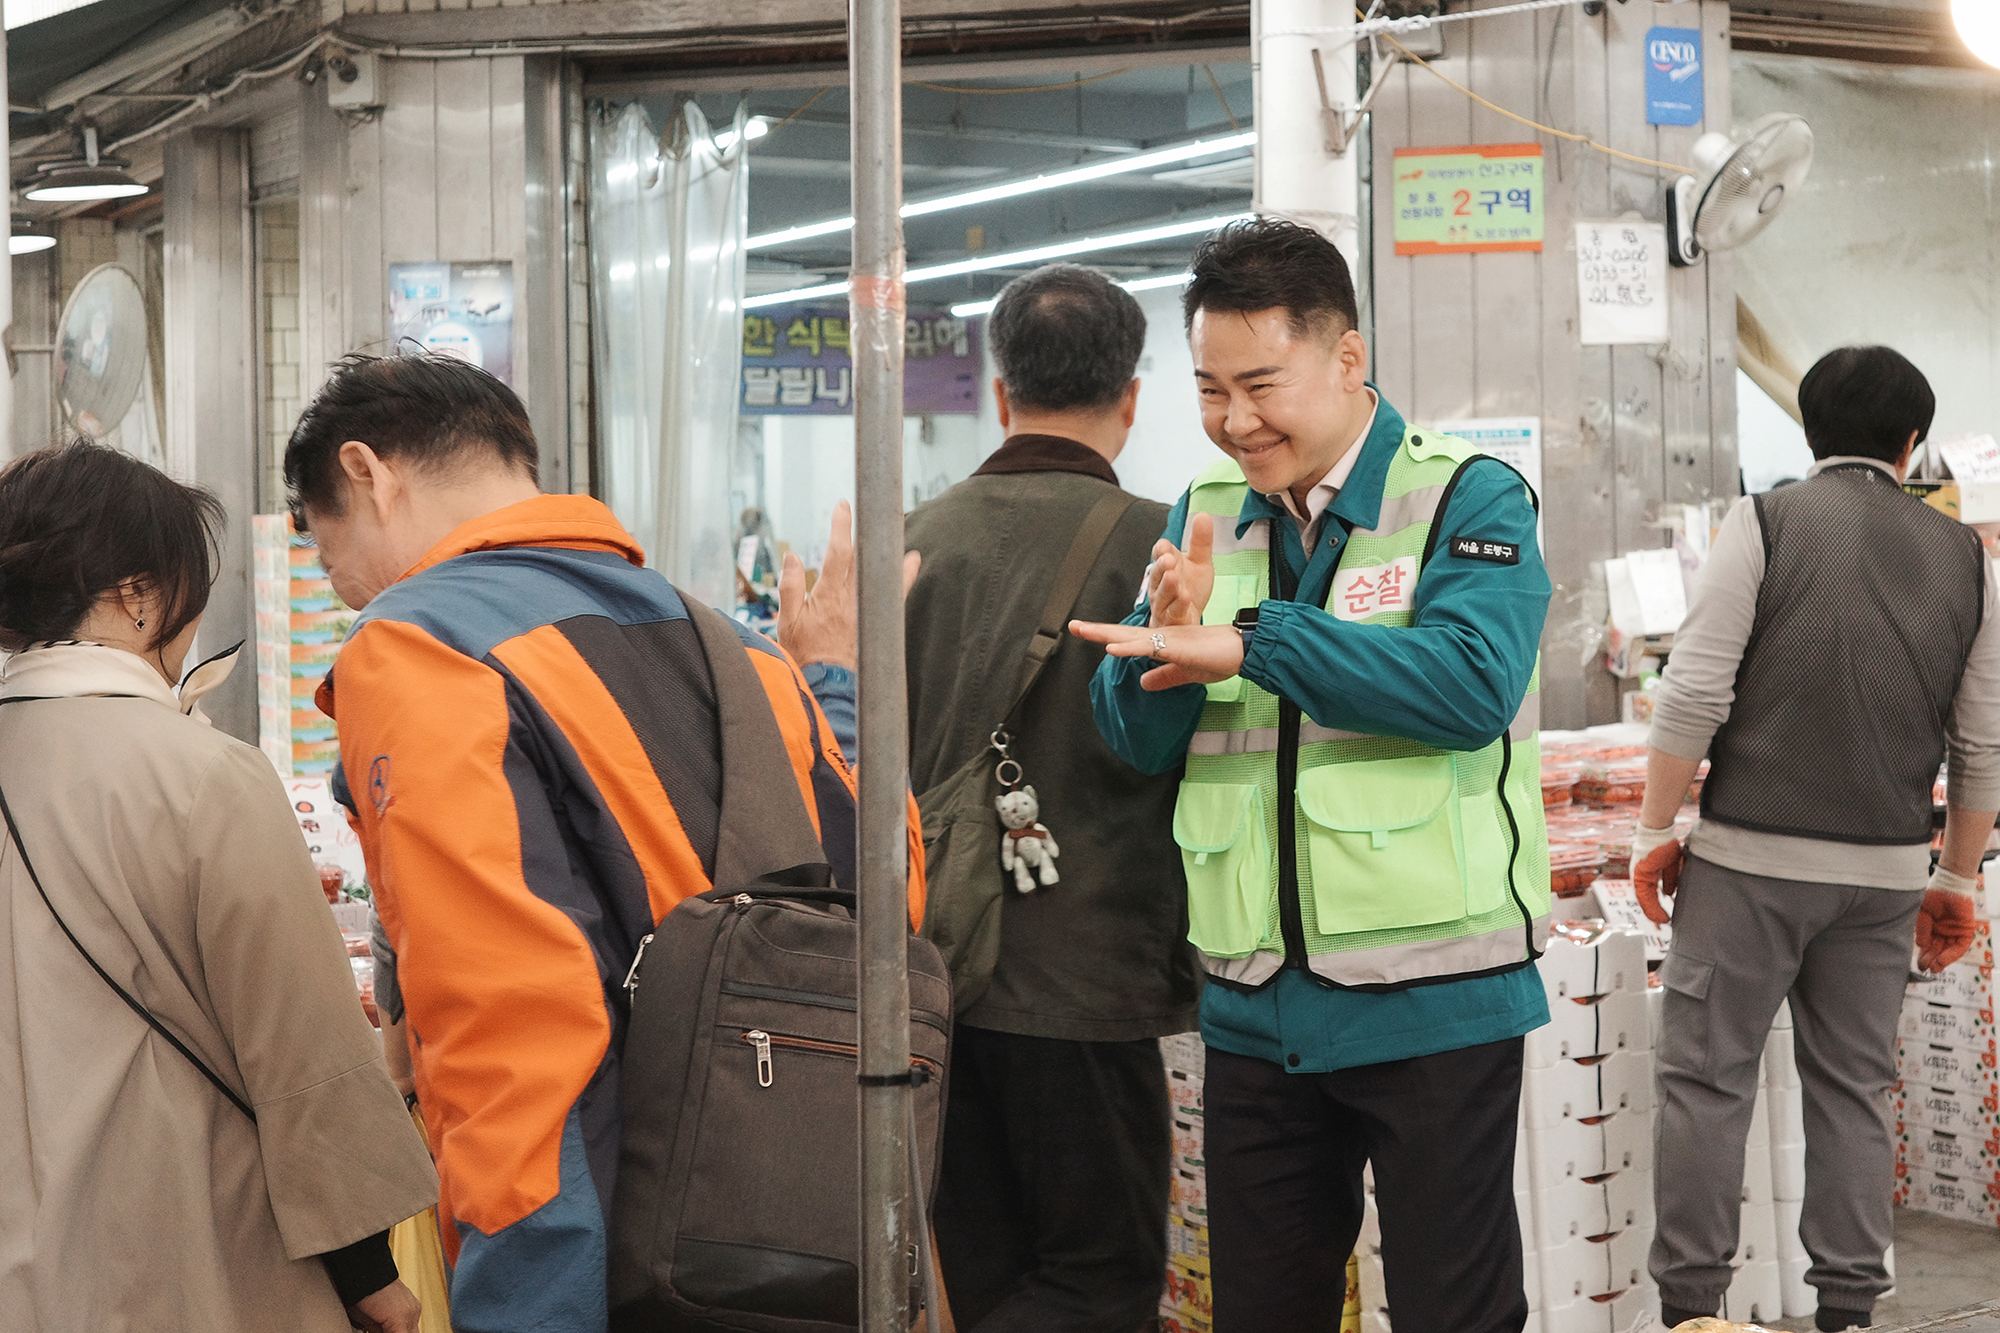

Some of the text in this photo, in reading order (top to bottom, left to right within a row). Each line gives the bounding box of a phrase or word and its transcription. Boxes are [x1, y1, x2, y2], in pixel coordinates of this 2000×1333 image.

[1453, 188, 1532, 216] 2 구역
[787, 316, 852, 357] 식탁
[743, 367, 850, 407] 달립니
[1458, 541, 1513, 558] 서울 도봉구
[1345, 565, 1406, 614] 순찰
